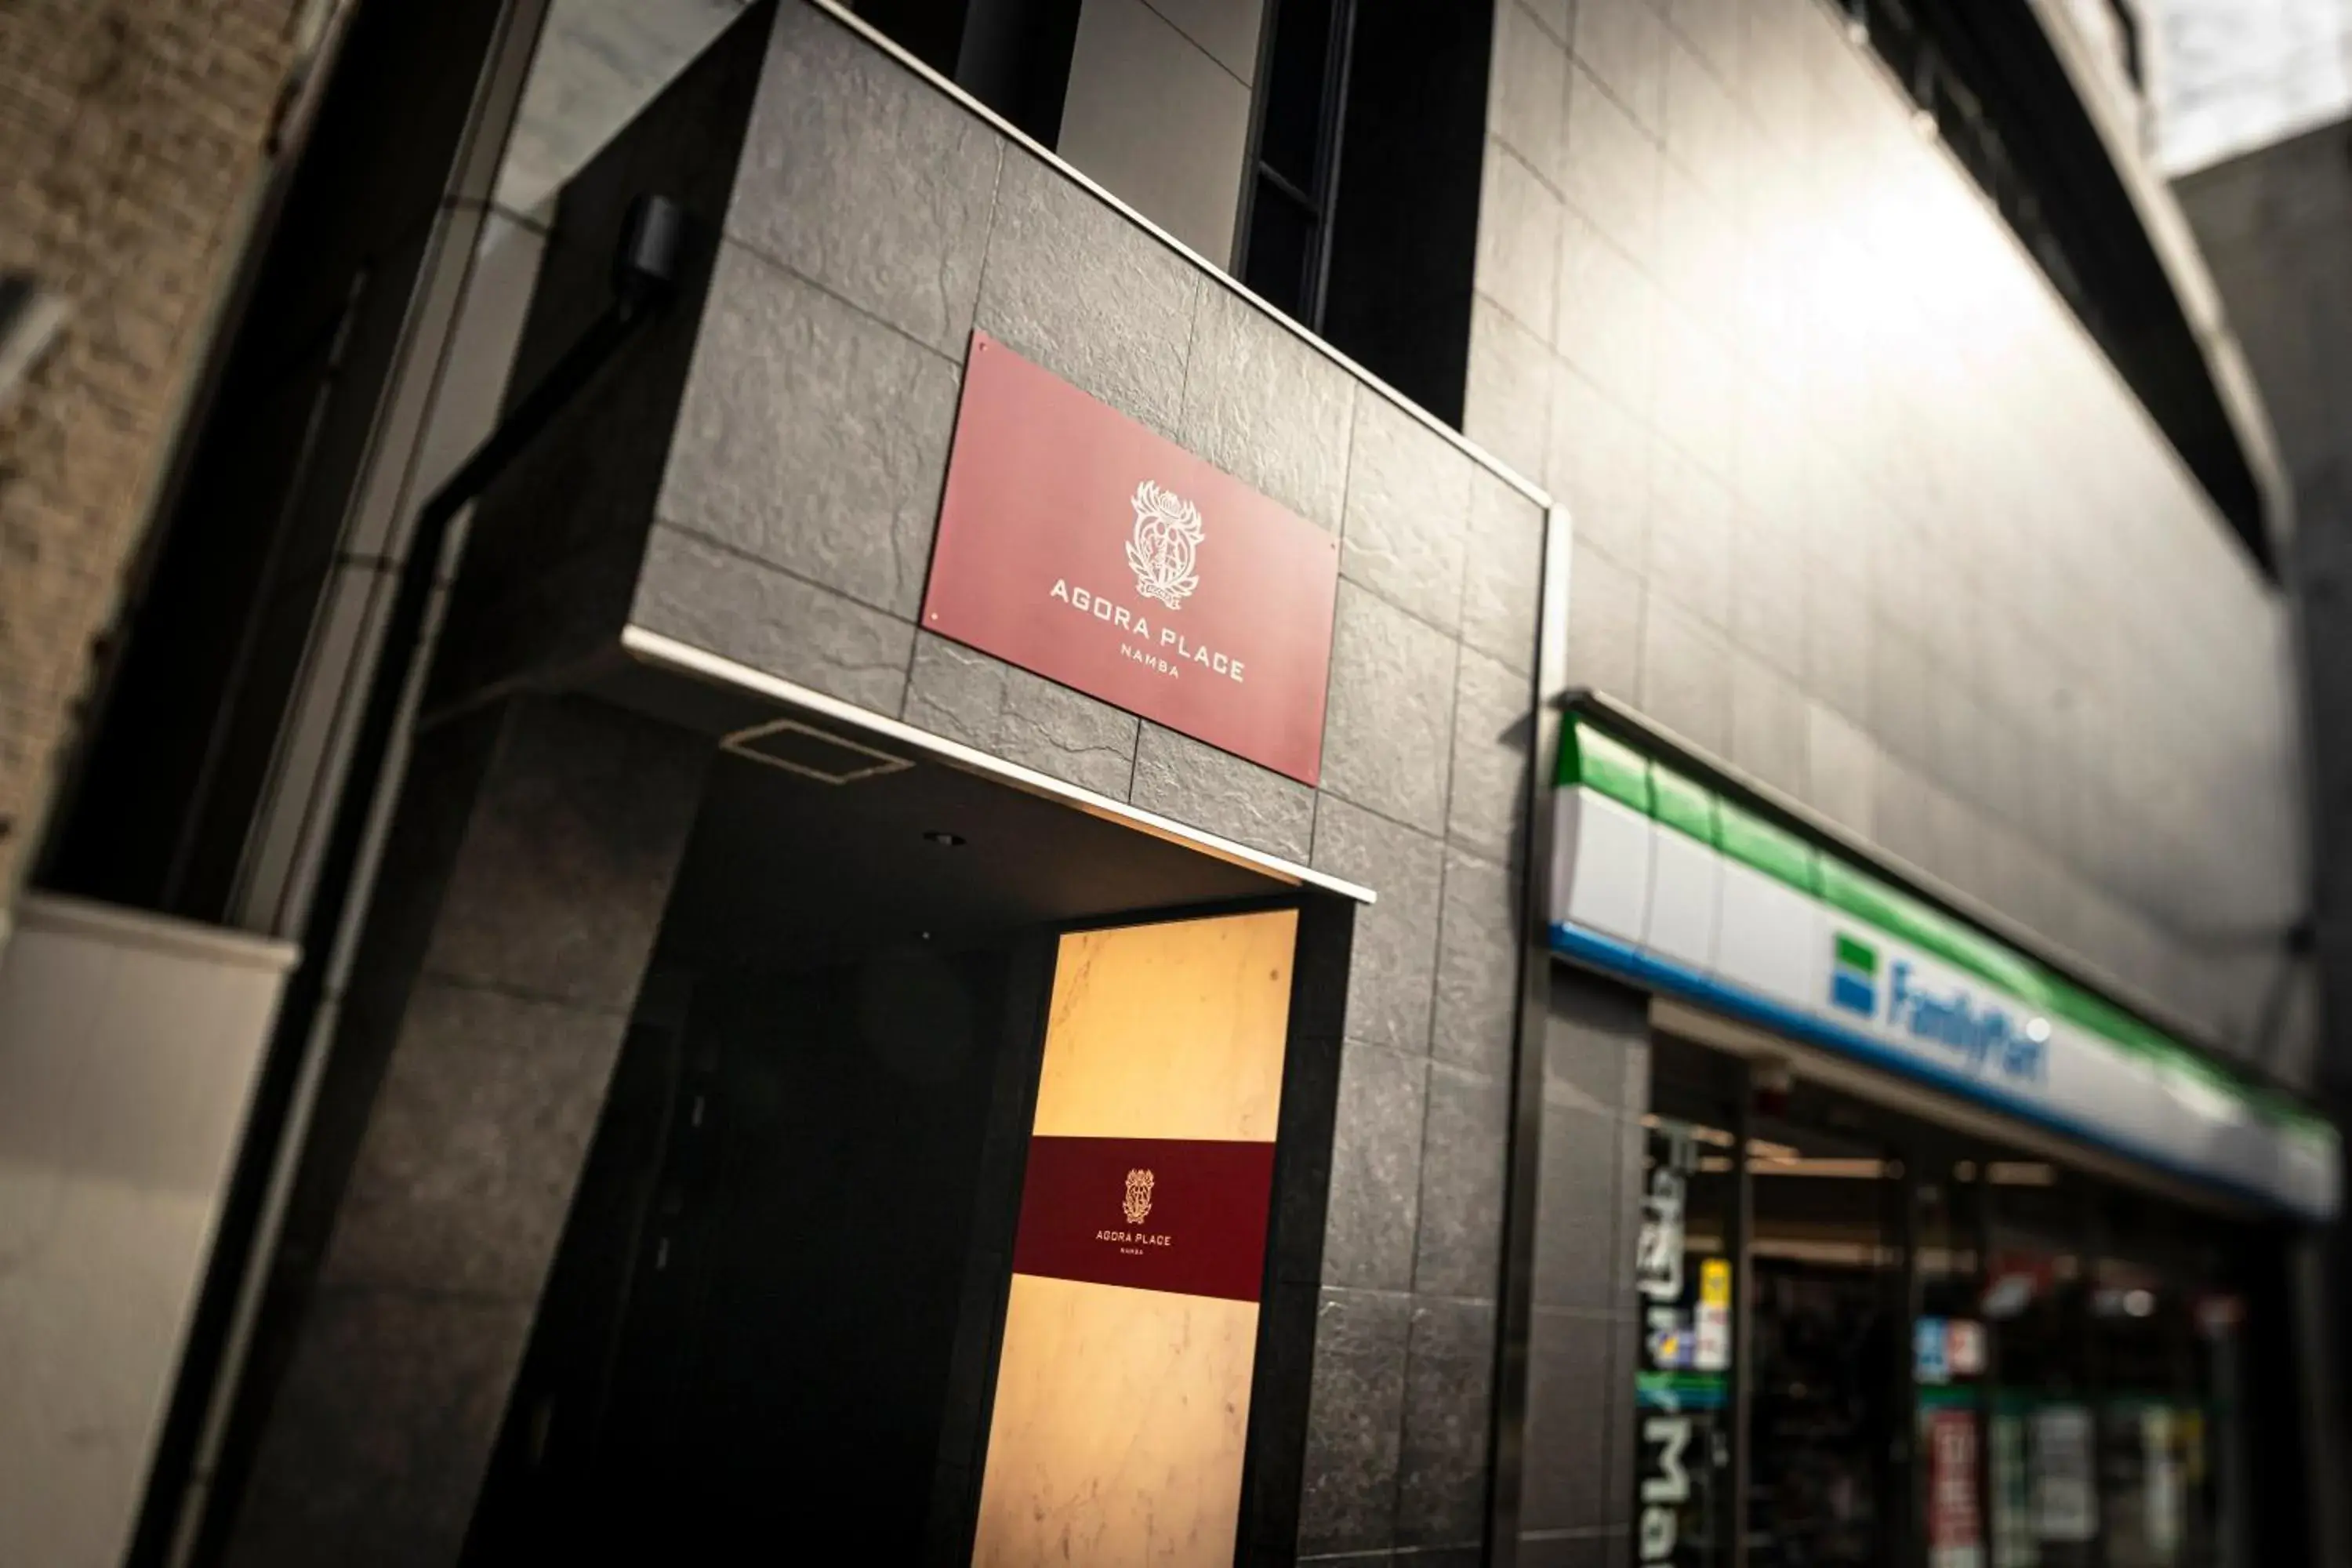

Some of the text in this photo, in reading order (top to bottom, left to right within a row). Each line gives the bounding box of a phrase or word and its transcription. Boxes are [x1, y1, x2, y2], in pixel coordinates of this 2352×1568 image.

[1050, 579, 1245, 683] AGORA PLACE
[1120, 643, 1179, 680] NAMBA
[1095, 1230, 1171, 1246] AGORA PLACE
